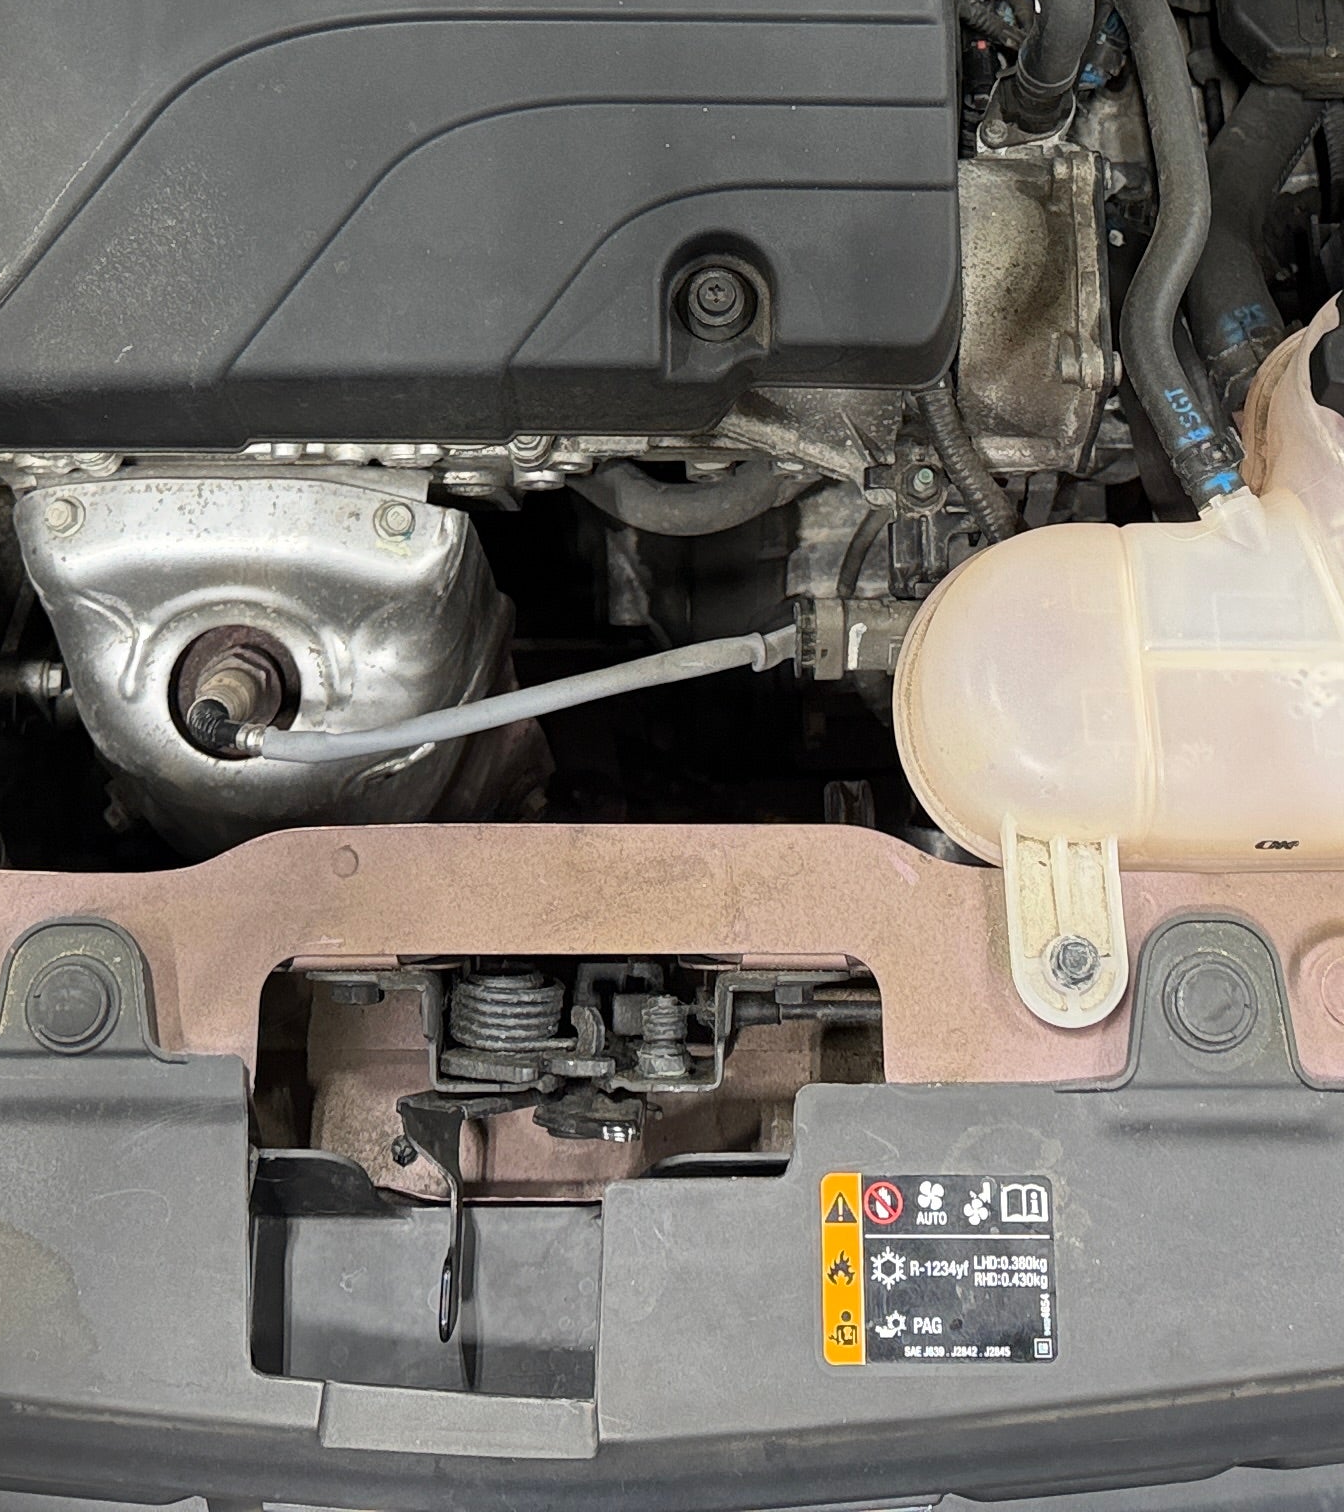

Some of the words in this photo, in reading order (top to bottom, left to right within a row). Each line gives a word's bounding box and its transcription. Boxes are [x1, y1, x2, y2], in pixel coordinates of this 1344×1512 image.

[916, 1210, 948, 1226] AUTO
[909, 1259, 969, 1280] R-1234yf
[973, 1255, 1048, 1273] LHD:0.380kg
[974, 1271, 1049, 1289] RHD:0.430kg
[913, 1317, 943, 1335] PAG
[904, 1346, 922, 1357] SAE
